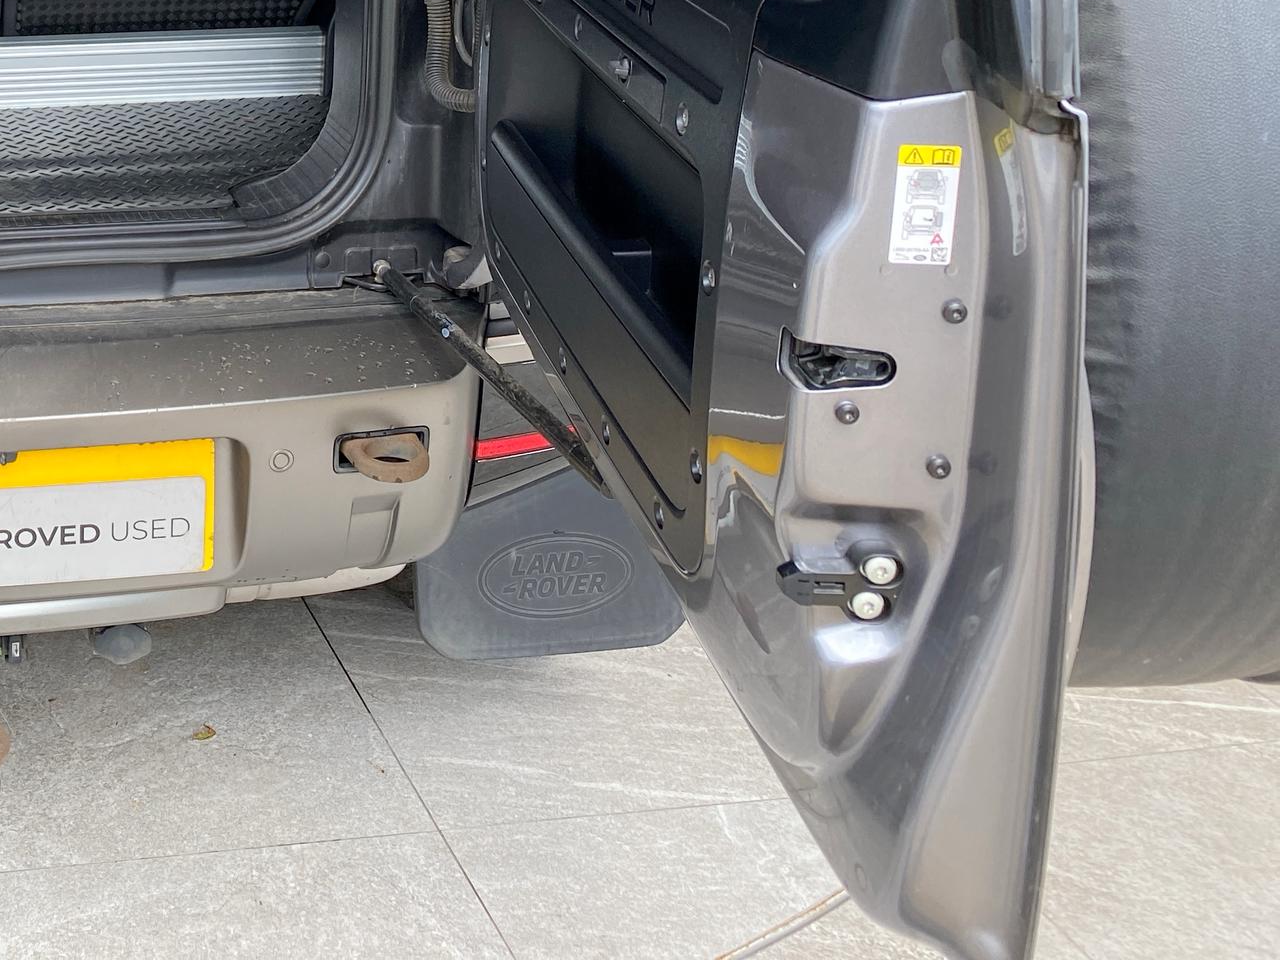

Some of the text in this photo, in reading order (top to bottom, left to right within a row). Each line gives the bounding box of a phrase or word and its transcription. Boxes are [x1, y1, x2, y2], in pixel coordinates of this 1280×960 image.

[110, 516, 191, 543] USED
[511, 551, 584, 577] LAND
[518, 572, 608, 600] ROVER
